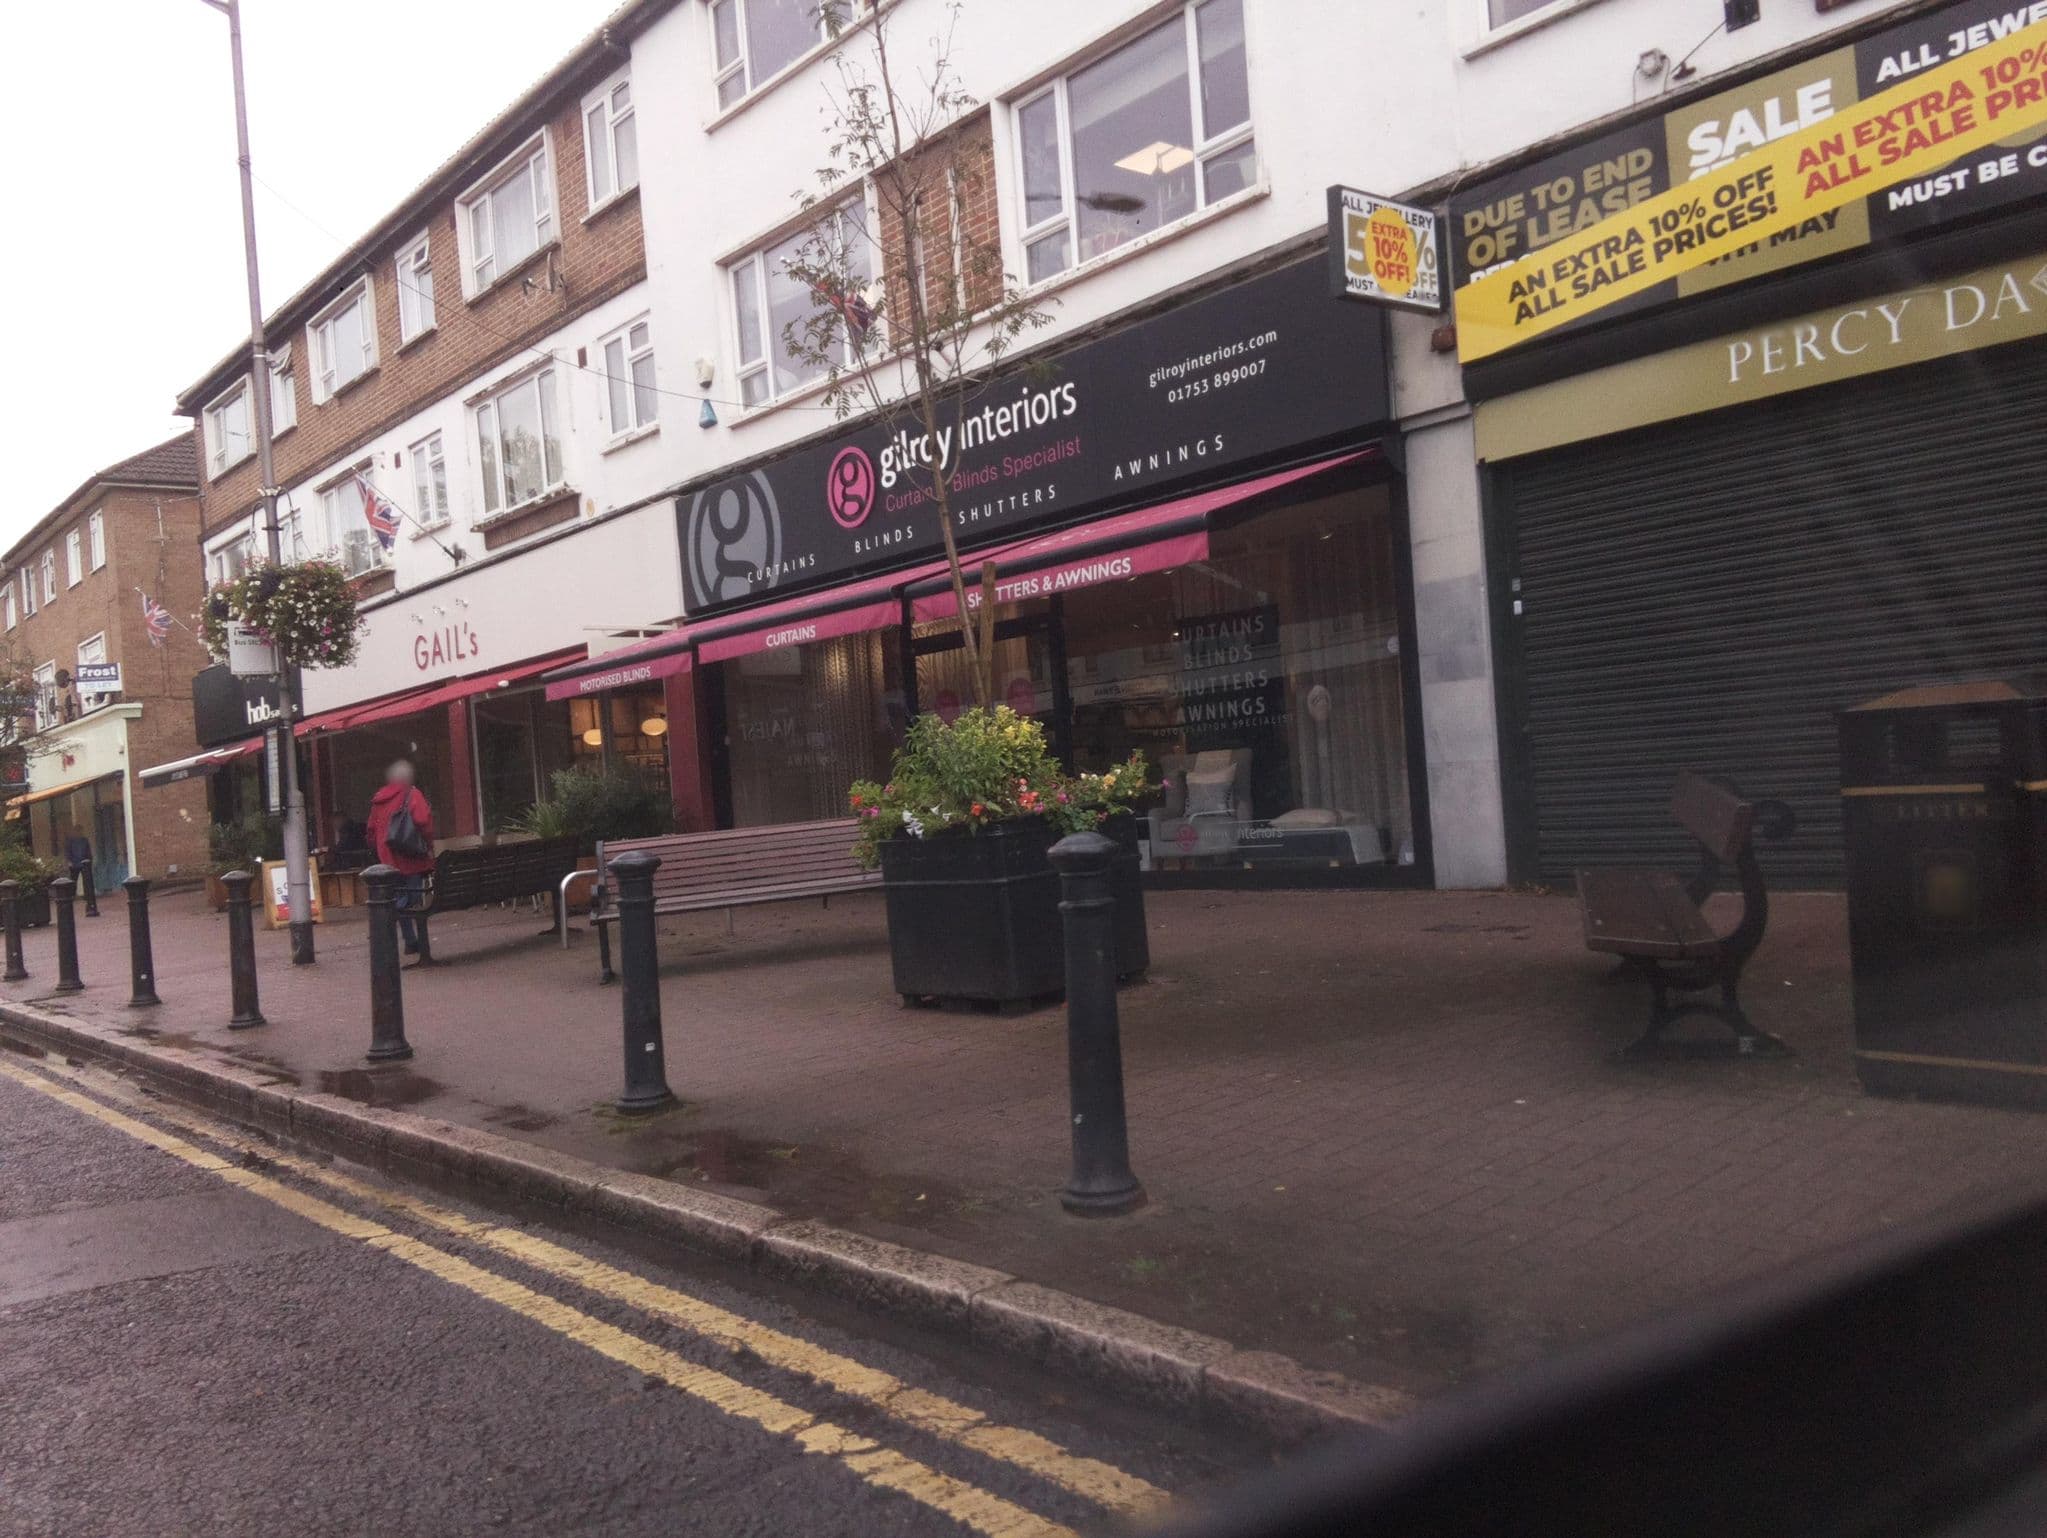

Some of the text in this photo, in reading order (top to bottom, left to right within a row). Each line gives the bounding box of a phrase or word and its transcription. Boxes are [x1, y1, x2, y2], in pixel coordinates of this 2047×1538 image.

[1876, 44, 1940, 83] ALL
[1687, 78, 1835, 168] SALE
[1797, 133, 1845, 175] AN
[1852, 80, 1975, 148] EXTRA
[1805, 154, 1871, 199] ALL
[1878, 104, 1977, 166] SALE
[1341, 195, 1364, 213] ALL
[1464, 193, 1526, 237] DUE
[1530, 176, 1575, 211] TO
[1583, 148, 1654, 194] END
[1888, 169, 1970, 211] MUST
[1978, 154, 2019, 184] BE
[1371, 222, 1408, 241] EXTRA
[1373, 236, 1408, 263] 10%
[1467, 225, 1518, 268] OF
[1526, 178, 1653, 248] LEASE
[1508, 268, 1547, 304] AN
[1552, 227, 1645, 282] EXTRA
[1649, 198, 1707, 238] 10%
[1713, 164, 1774, 208] OFF
[1374, 259, 1411, 284] OFF!
[1514, 288, 1567, 325] ALL
[1571, 248, 1647, 299] SALE
[1653, 190, 1778, 263] PRICES!
[1149, 330, 1278, 388] gilroyinteriors.com
[1728, 298, 1912, 384] PERCY
[1168, 359, 1266, 402] 01753 899007
[953, 464, 998, 492] Blinds
[1002, 435, 1082, 478] Specialist
[747, 434, 1225, 584] CURTAINS BLINDS SHUTTERS AWNINGS
[967, 557, 1132, 609] SHTTERS & AWNINGS
[765, 625, 816, 648] CURTAINS
[1183, 644, 1253, 670] BLINDS
[78, 666, 117, 678] Frost
[579, 666, 651, 692] MOTORISED BLINDS
[246, 696, 271, 725] hob
